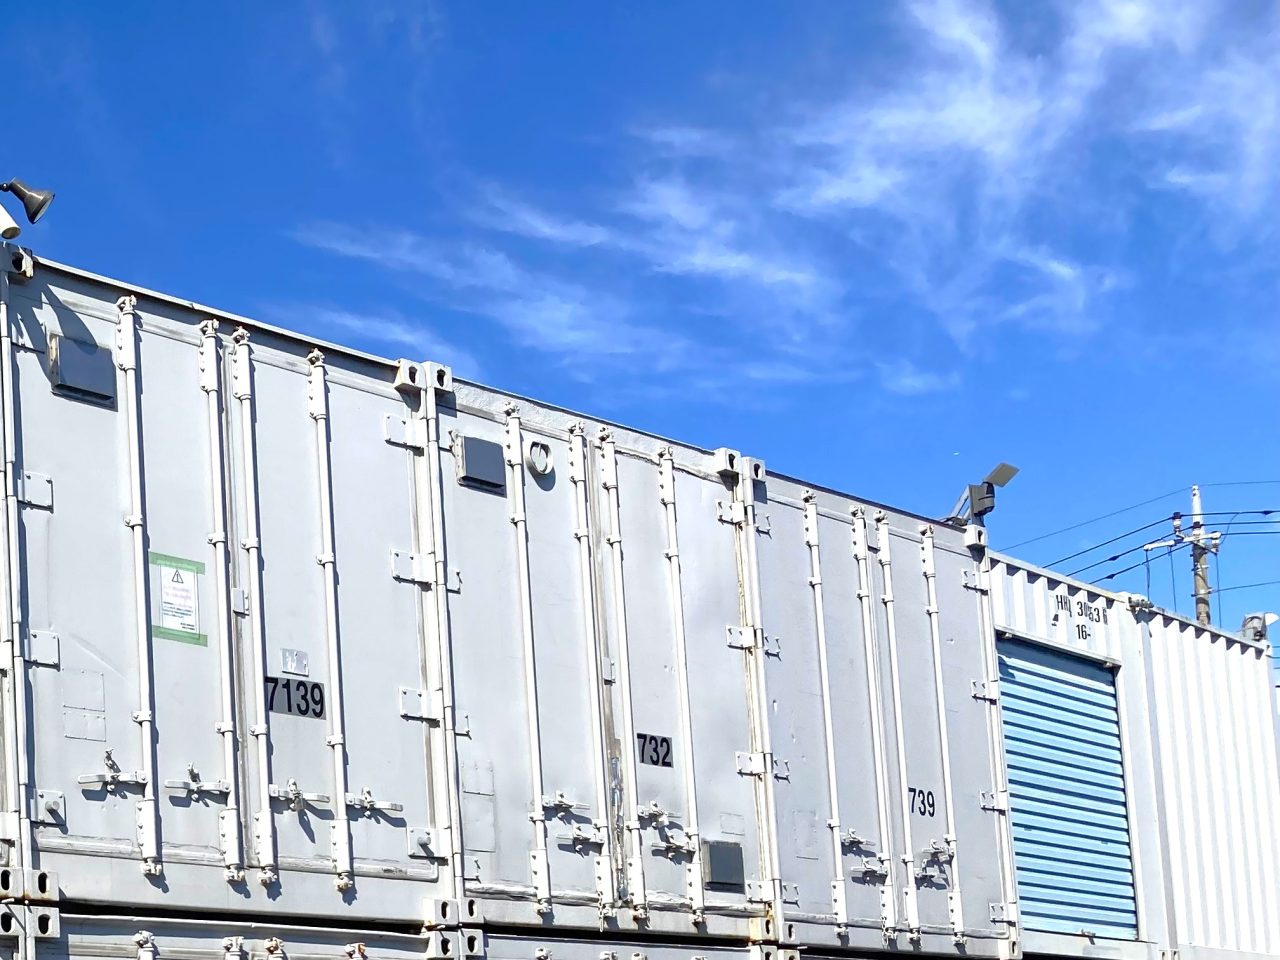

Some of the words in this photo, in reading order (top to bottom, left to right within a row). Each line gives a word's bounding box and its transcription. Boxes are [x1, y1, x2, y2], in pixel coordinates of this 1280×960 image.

[264, 676, 324, 718] 7139
[637, 733, 672, 767] 732
[908, 787, 935, 817] 739
